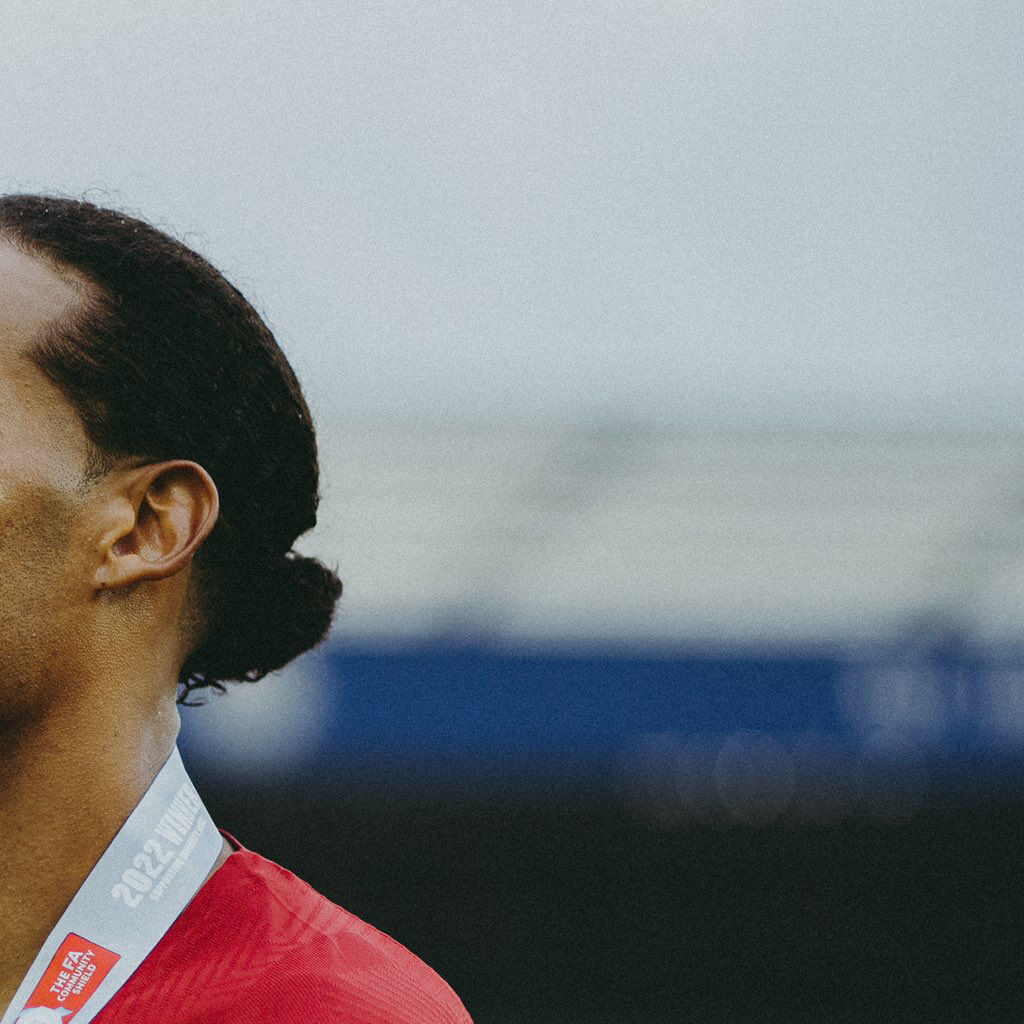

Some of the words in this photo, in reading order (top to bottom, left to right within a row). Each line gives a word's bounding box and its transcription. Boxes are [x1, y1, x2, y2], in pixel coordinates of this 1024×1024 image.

[109, 837, 174, 909] 2022
[50, 971, 70, 992] THE
[62, 951, 84, 970] FA
[57, 949, 95, 1002] COMMUNITY
[72, 964, 96, 994] SHIELD
